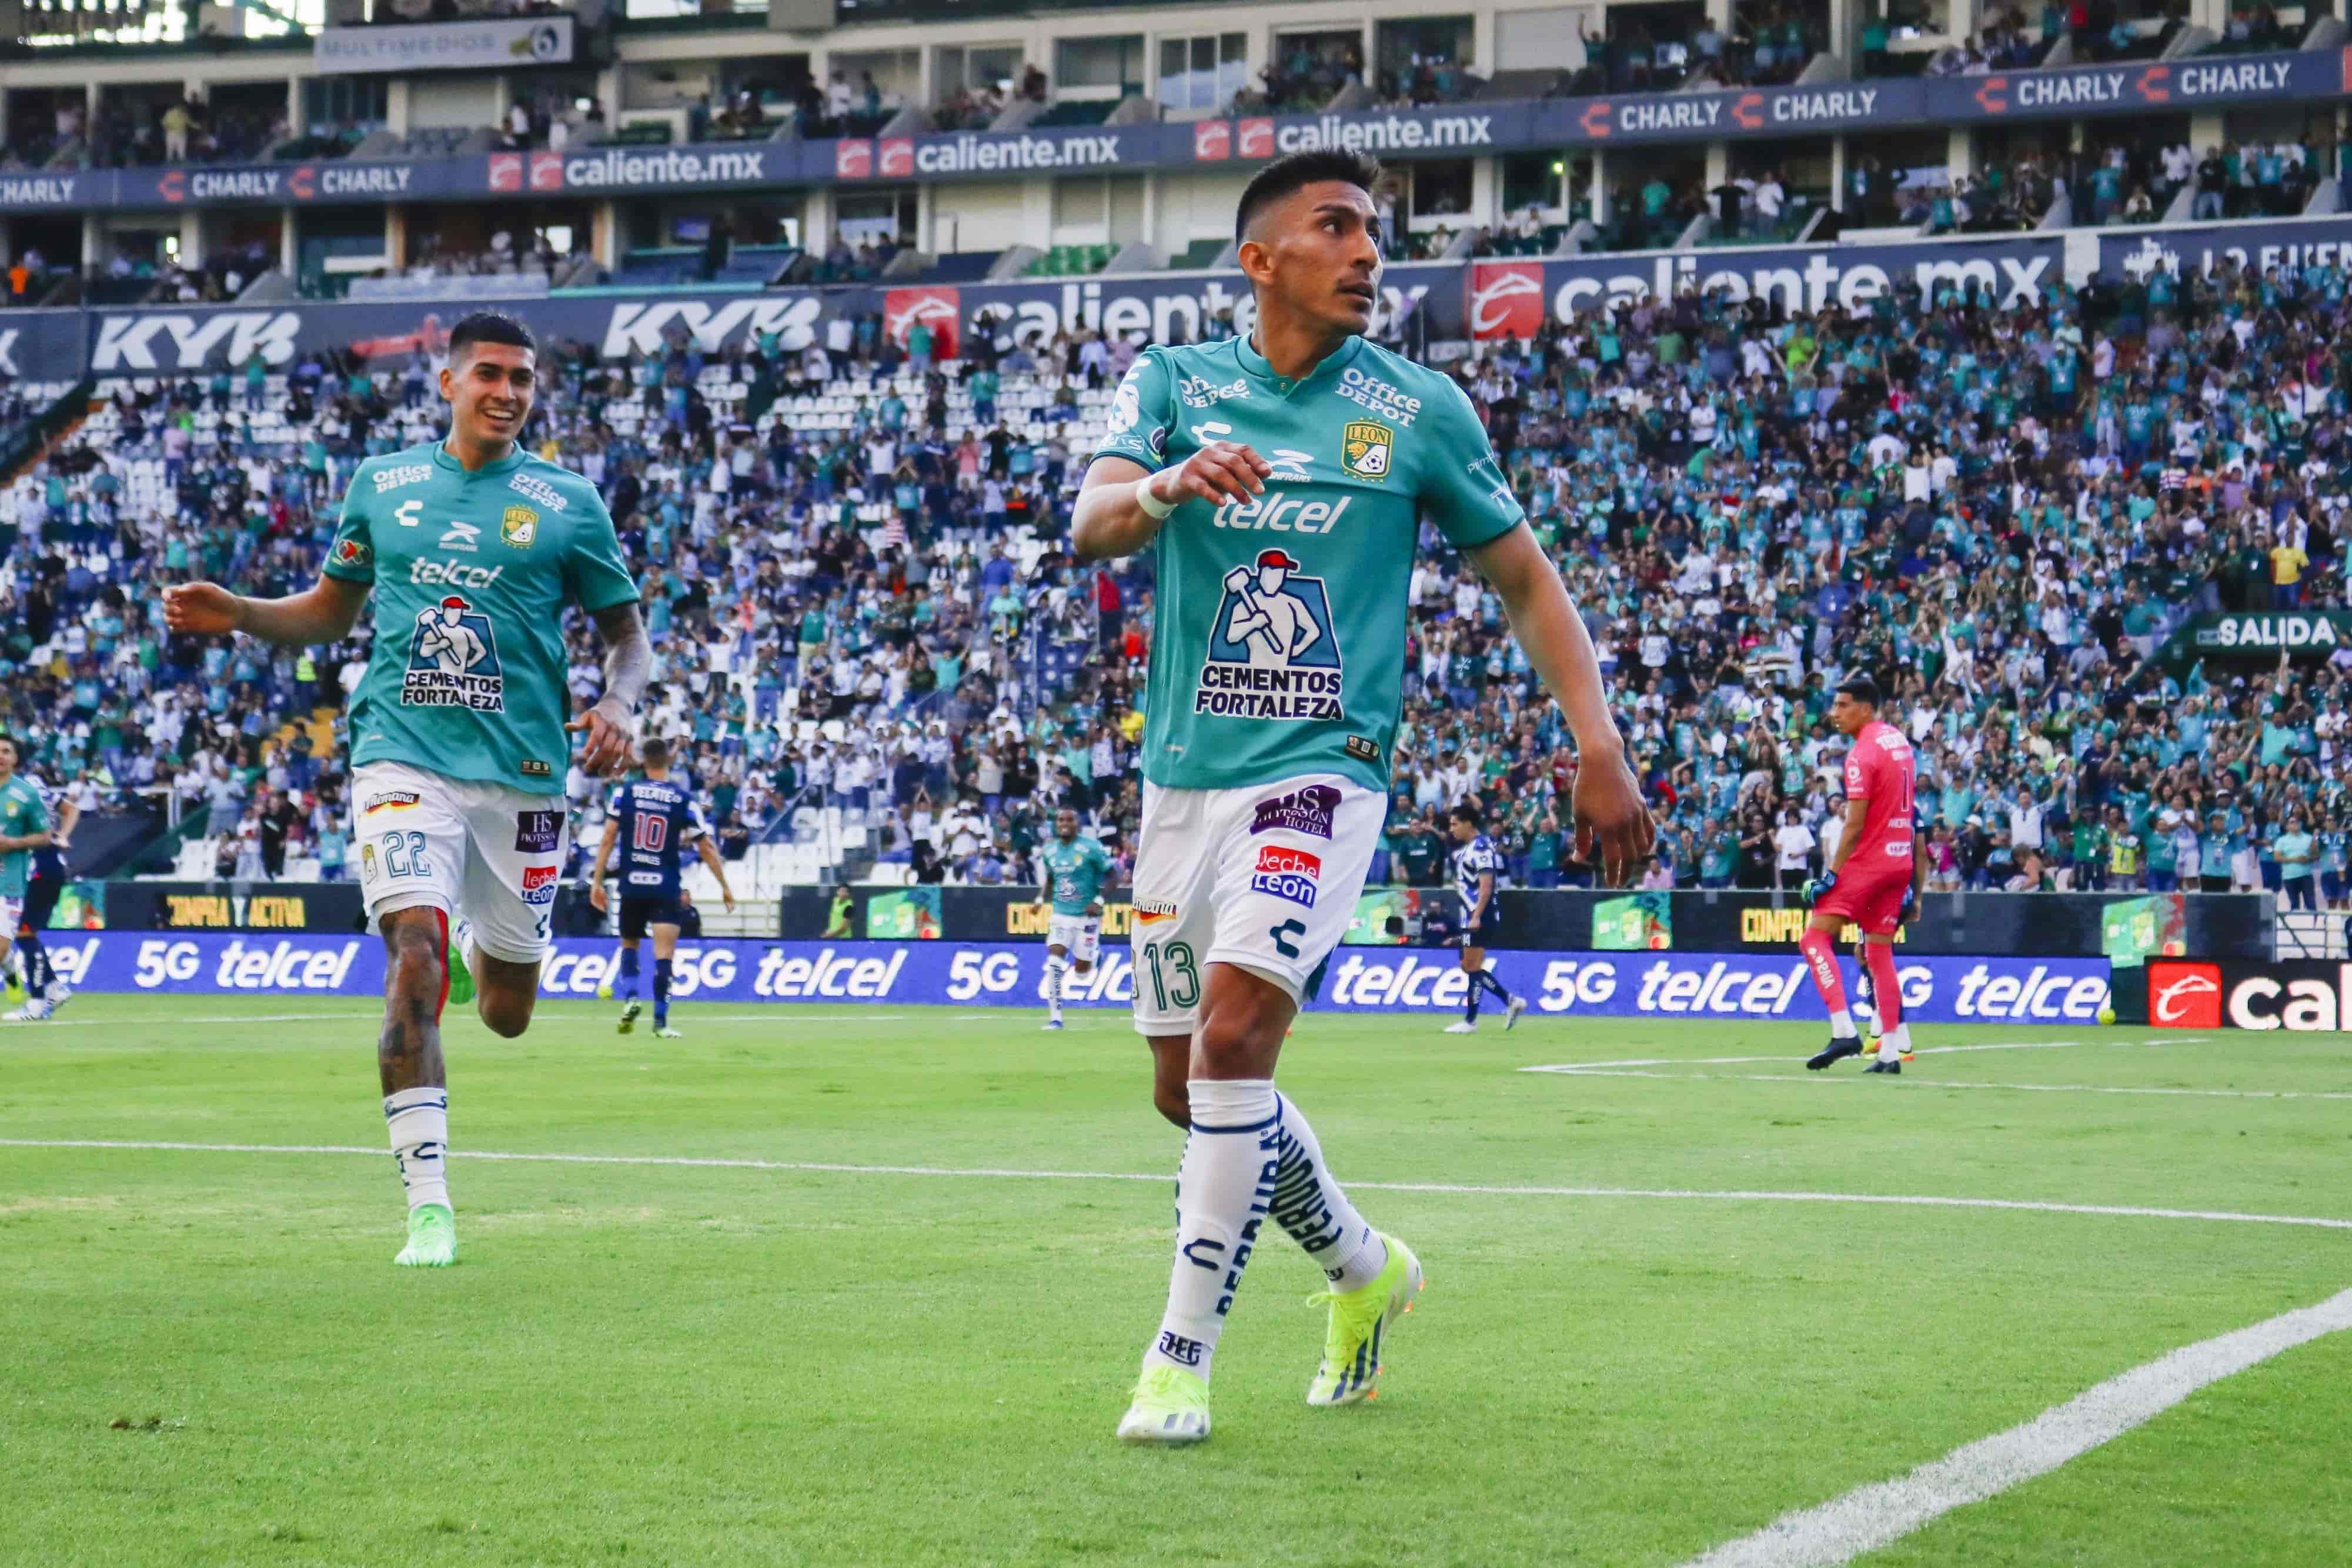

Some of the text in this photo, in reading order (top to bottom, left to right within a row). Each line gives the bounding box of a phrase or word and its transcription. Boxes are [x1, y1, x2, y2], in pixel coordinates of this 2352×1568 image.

[322, 35, 497, 58] MULTIMEDIOS
[2018, 74, 2124, 106] CHARLY
[2181, 62, 2291, 95] CHARLY
[1620, 101, 1722, 131] CHARLY
[1773, 89, 1877, 119] CHARLY
[1278, 116, 1492, 155] caliente.mx
[566, 151, 763, 188] caliente.mx
[917, 135, 1120, 173] caliente.mx
[0, 179, 75, 203] HARLY
[192, 172, 280, 197] CHARLY
[322, 167, 410, 193] CHARLY
[1554, 254, 2052, 326] calientemx
[92, 313, 302, 370] KYB
[603, 299, 822, 357] KYB
[1334, 382, 1417, 428] DEPOT
[1343, 367, 1422, 414] Office
[507, 479, 563, 513] DEPOT
[513, 473, 568, 507] Office
[1213, 492, 1352, 534] telcel
[409, 556, 505, 589] telcel
[2219, 616, 2337, 647] SALIDA
[404, 671, 503, 694] CEMENTOS
[1201, 664, 1342, 696] CEMENTOS
[401, 687, 505, 713] FORTALEZA
[1195, 689, 1344, 721] FORTALEZA
[532, 813, 552, 833] HS
[633, 811, 668, 852] 10
[1285, 815, 1327, 836] HOTEL
[383, 830, 432, 878] 22
[1257, 850, 1318, 880] leche
[526, 869, 556, 888] leche
[232, 896, 246, 928] Y
[133, 940, 360, 989] 5G telcel
[539, 944, 622, 994] lcel
[669, 947, 908, 998] 5G telcel
[946, 951, 1019, 1001] 5G
[1143, 940, 1201, 1012] 13
[1538, 960, 1618, 1012] 5G
[1636, 959, 1809, 1015] telcel
